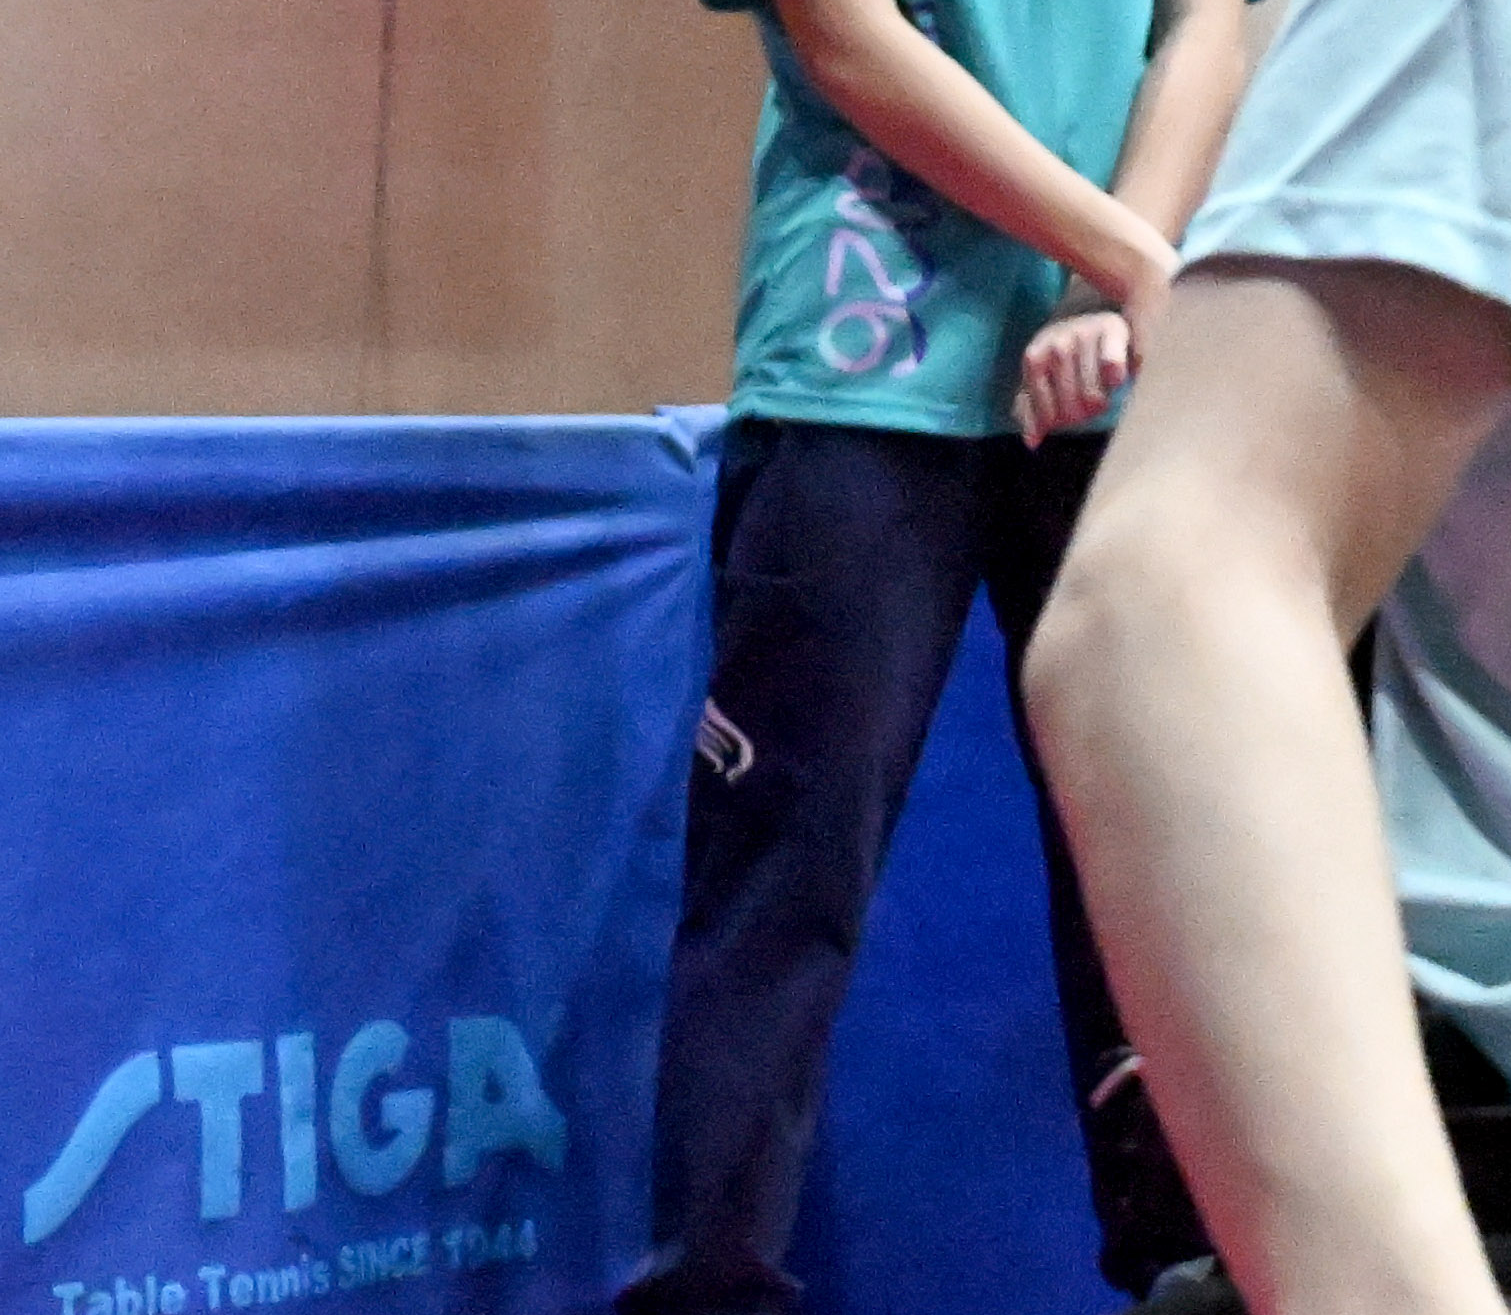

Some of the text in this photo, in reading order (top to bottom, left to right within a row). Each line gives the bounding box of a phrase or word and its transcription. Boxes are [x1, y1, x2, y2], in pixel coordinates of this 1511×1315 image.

[22, 1014, 567, 1245] STIGA
[197, 1253, 331, 1310] Tennis
[336, 1231, 431, 1289] SINCE
